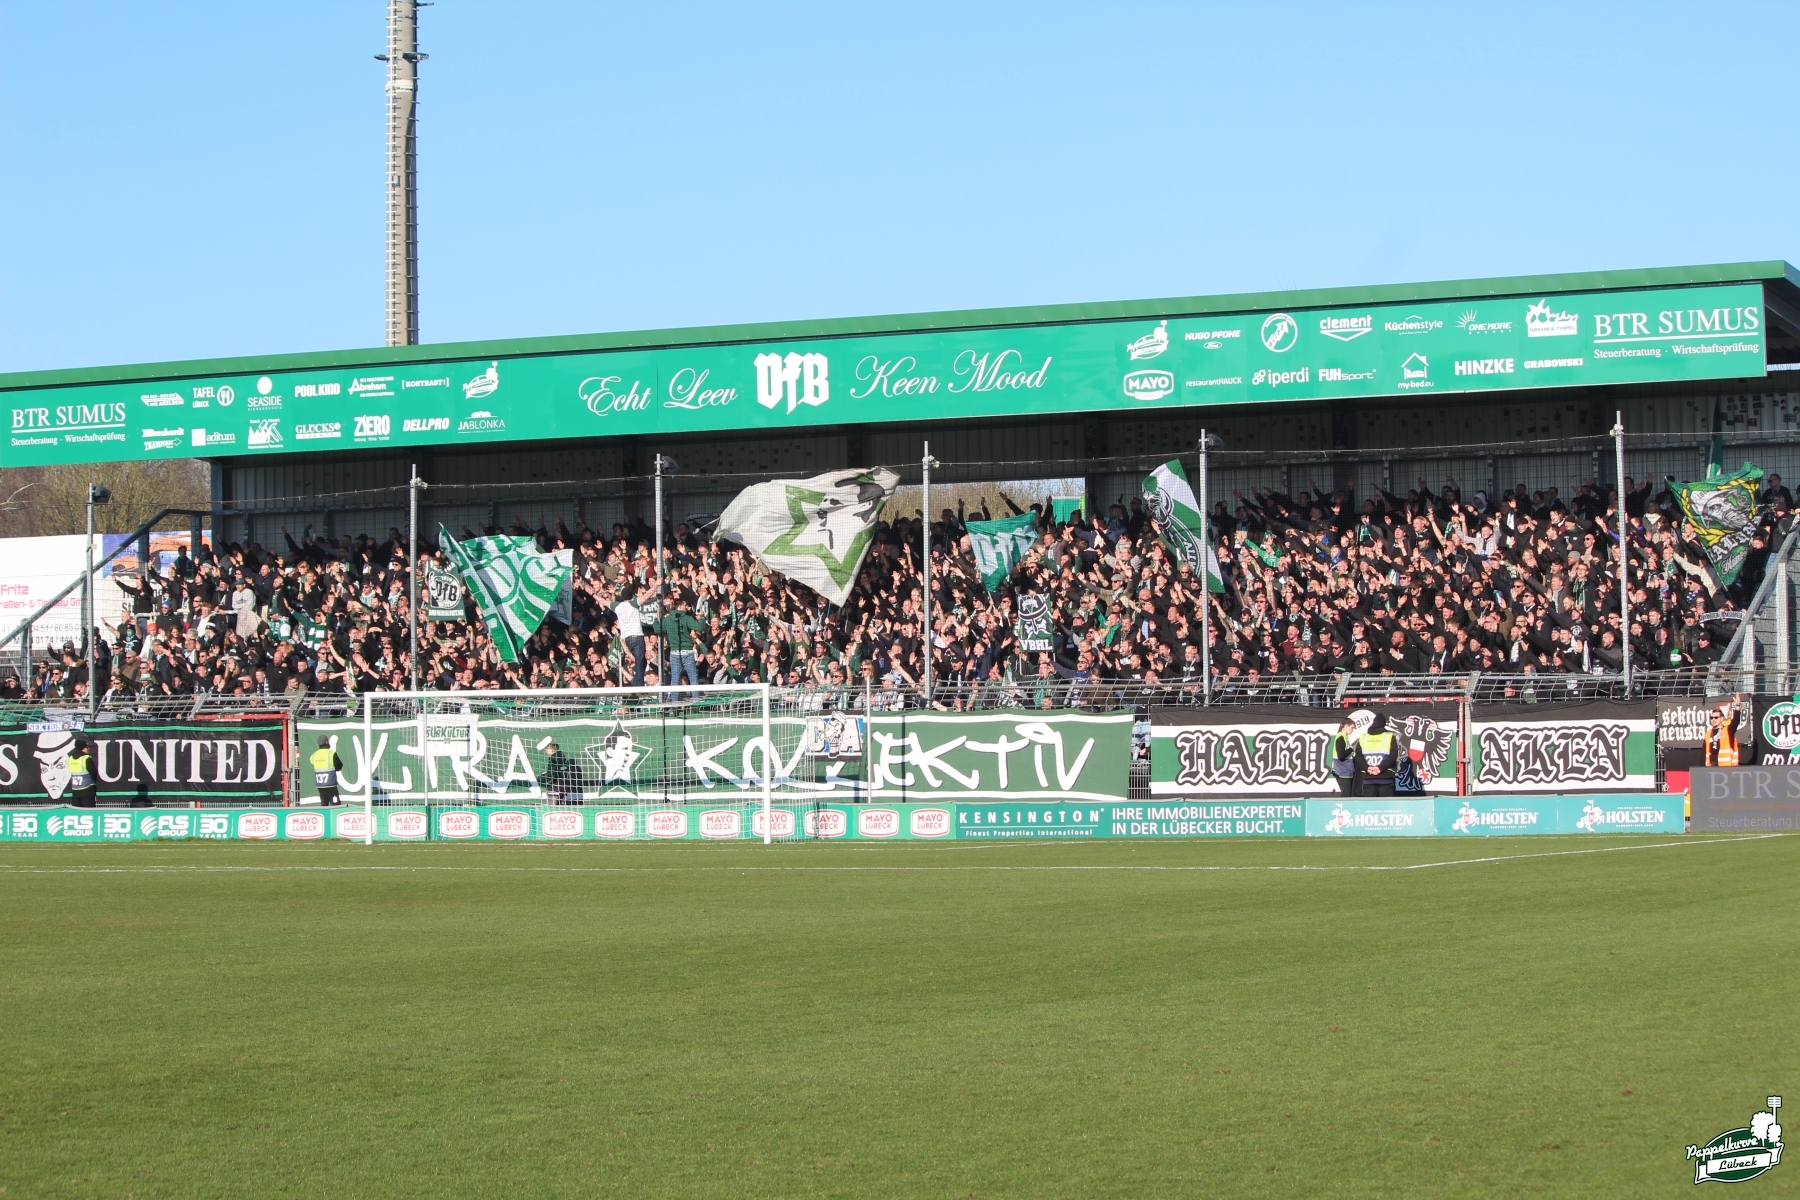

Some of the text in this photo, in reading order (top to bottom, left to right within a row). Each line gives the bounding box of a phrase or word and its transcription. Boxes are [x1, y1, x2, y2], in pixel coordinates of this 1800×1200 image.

[1320, 315, 1372, 329] clement
[1385, 320, 1443, 331] Küchenstyle
[1468, 322, 1512, 331] ONE MORE
[1594, 306, 1758, 337] BTR SUMUS
[1185, 330, 1241, 340] HUGO PFOHE
[1594, 342, 1758, 358] Steuerberatung Wirtschaftsprüfung
[1454, 358, 1514, 376] HINZKE
[1524, 358, 1583, 369] GRABOWSKI
[850, 349, 1052, 398] Keen Mood
[1268, 367, 1309, 388] iperdi
[348, 378, 386, 395] Abraham
[754, 352, 829, 415] VfB
[1129, 376, 1169, 390] MAYO
[1186, 377, 1242, 387] restaurantHAUCK
[1398, 380, 1434, 389] my-bed.eu
[193, 387, 215, 398] TAFEL
[578, 368, 738, 416] Echt Leev
[193, 400, 209, 408] LÜBECK
[248, 396, 282, 407] SEASIDE
[12, 402, 126, 428] BTR SUMUS
[354, 414, 390, 436] ZERO
[403, 418, 450, 432] DELLPRO
[458, 419, 505, 430] JABLONKA
[11, 432, 125, 446] Steuerberatung Wirtschaftsprüfung
[206, 432, 235, 442] aditum
[1, 584, 29, 595] Fritz
[1020, 640, 1053, 651] VBHL
[1356, 716, 1370, 728] 919
[1660, 726, 1705, 742] neusta
[94, 739, 276, 784] UNITED
[1366, 756, 1383, 766] 202
[316, 774, 329, 783] 137
[1708, 771, 1776, 799] BTR
[654, 815, 680, 823] MAYO
[706, 815, 733, 823] MAYO
[812, 814, 839, 822] MAYO
[866, 814, 892, 822] MAYO
[918, 814, 943, 822] MAYO
[960, 810, 1099, 824] KENSINGTON
[1112, 806, 1301, 820] IHRE IMMOBILIENEXPERTEN
[1481, 812, 1537, 824] HOLSTEN
[1606, 810, 1663, 823] HOLSTEN
[13, 818, 37, 832] 30
[63, 815, 93, 830] FLS
[104, 818, 131, 833] 30
[158, 815, 189, 830] FLS
[200, 818, 228, 833] 30
[447, 816, 472, 824] MAYO
[1355, 814, 1412, 826] HOLSTEN
[1709, 816, 1792, 828] Steuerberatung
[1112, 820, 1285, 834] IN DER LÜBECKER BUCHT.
